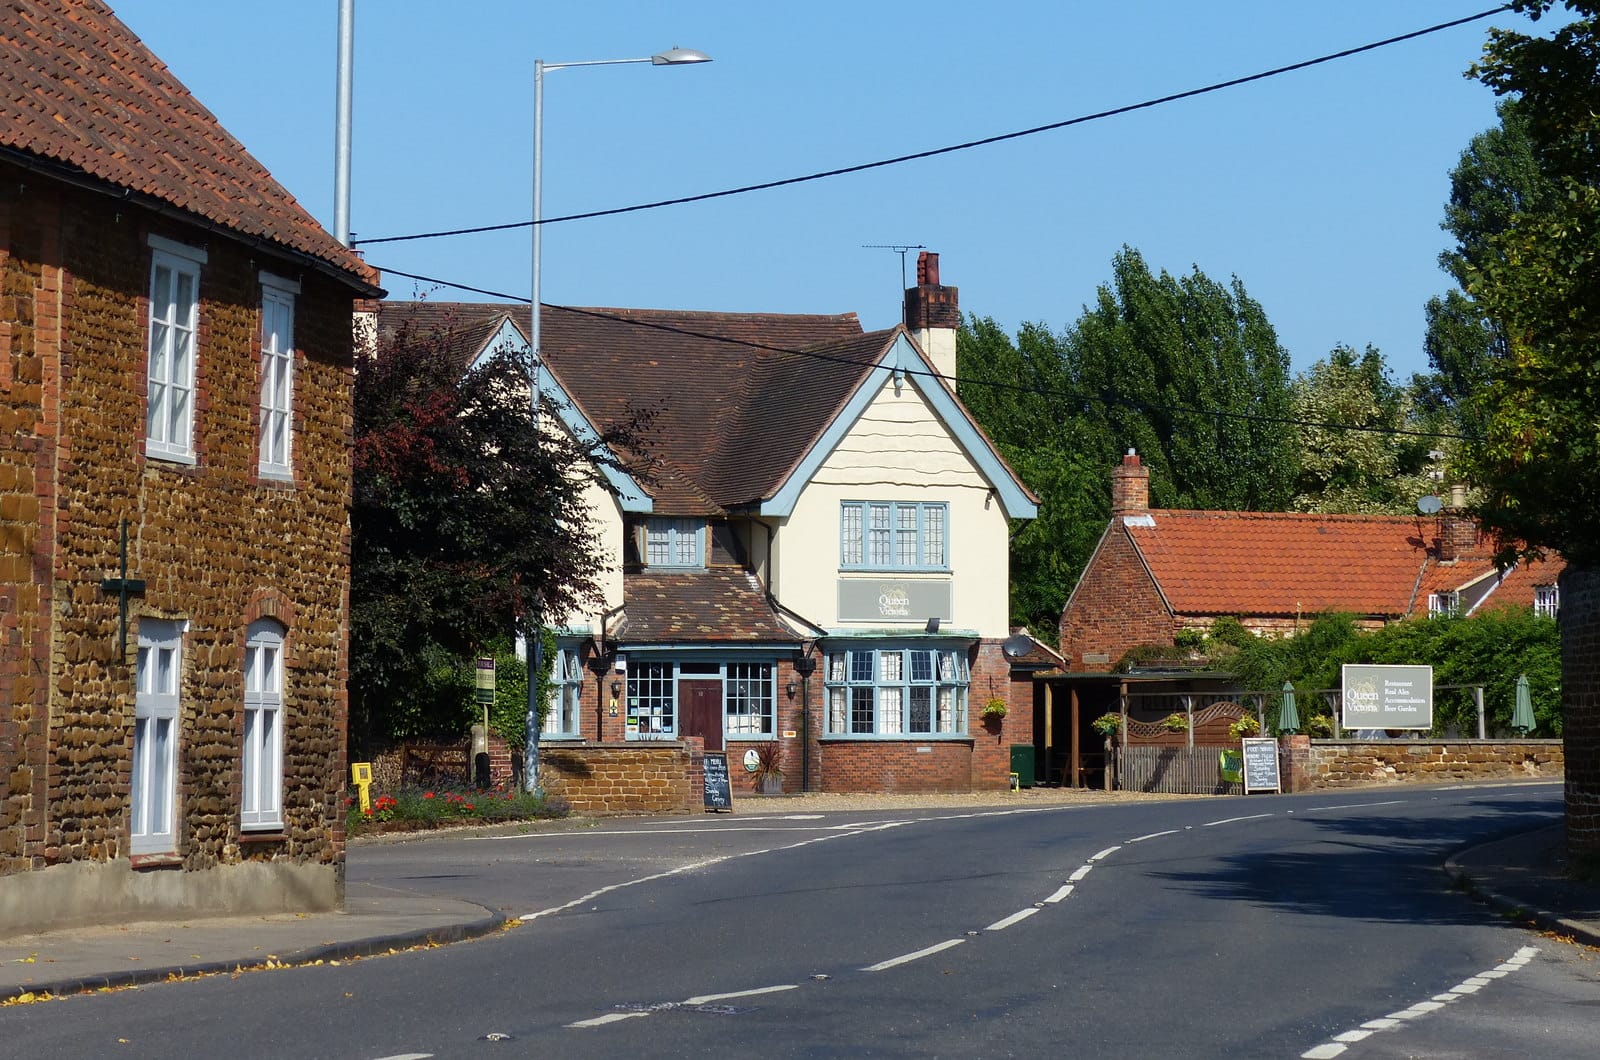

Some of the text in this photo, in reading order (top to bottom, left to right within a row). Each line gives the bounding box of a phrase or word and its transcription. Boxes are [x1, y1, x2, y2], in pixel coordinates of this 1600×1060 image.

[879, 594, 909, 608] Queen
[878, 606, 908, 616] Victoria
[1384, 679, 1413, 687] Restaurant
[1347, 688, 1379, 702] Queen
[1346, 702, 1378, 712] Victoria
